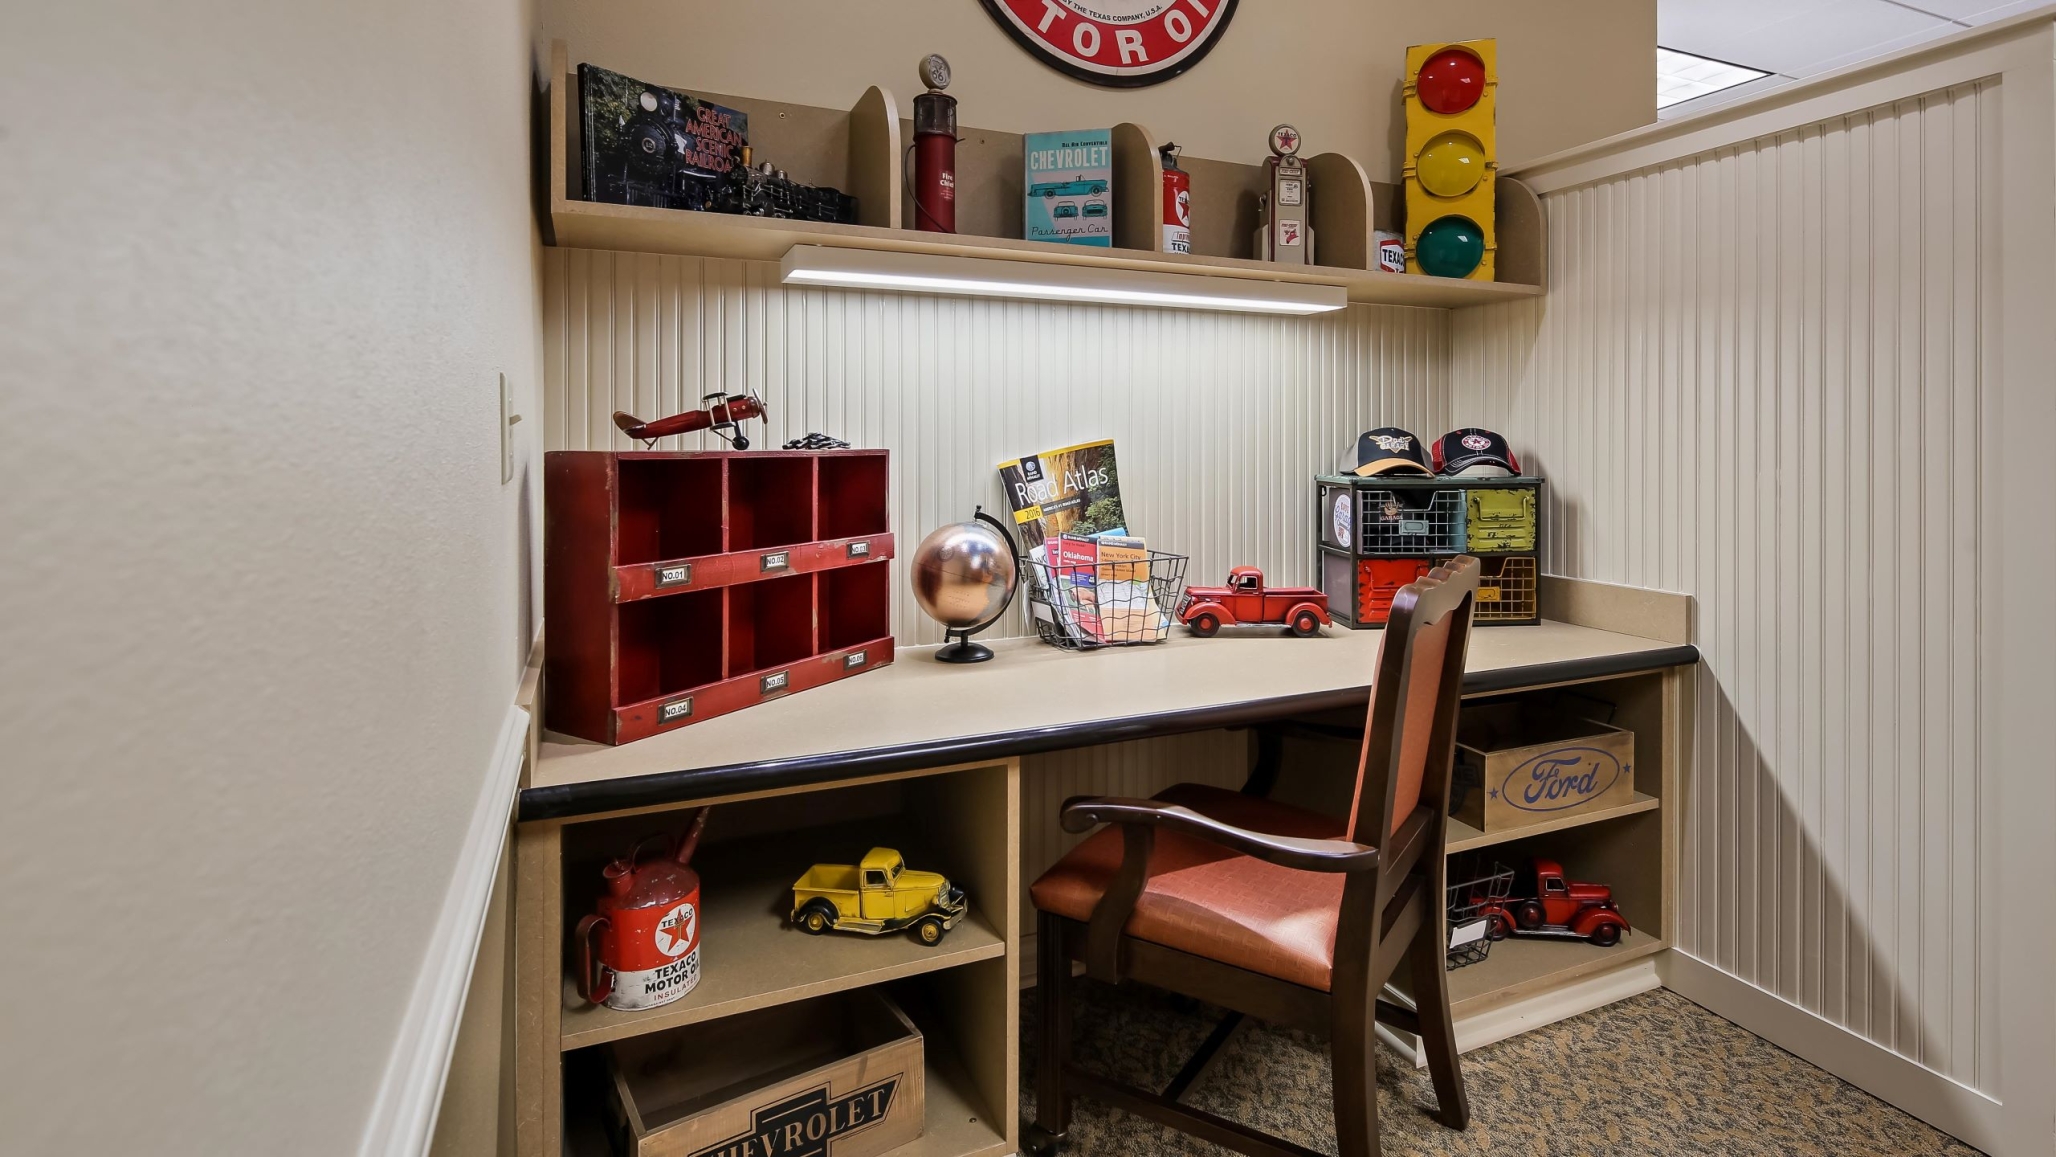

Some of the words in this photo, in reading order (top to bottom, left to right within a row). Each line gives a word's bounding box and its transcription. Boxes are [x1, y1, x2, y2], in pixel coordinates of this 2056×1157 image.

[1073, 2, 1087, 14] THE
[1088, 9, 1111, 21] TEXAS
[1112, 13, 1146, 22] COMPANY,
[696, 106, 732, 128] GREAT
[685, 118, 743, 148] AMERICAN
[695, 136, 734, 159] SCENIC
[1030, 146, 1108, 170] CHEVROLET
[685, 148, 733, 173] RAILROA
[1031, 226, 1086, 242] Passenger
[1087, 223, 1109, 233] Car
[1014, 473, 1059, 506] Road
[1063, 464, 1109, 494] Atlas
[1024, 507, 1041, 520] 2016
[766, 555, 785, 565] NO.02
[1063, 550, 1094, 562] Oklahoma
[1130, 553, 1142, 561] City
[662, 570, 684, 580] NO.01
[848, 654, 864, 664] NO.06
[766, 676, 785, 688] NO.05
[665, 703, 687, 717] NO.04
[1523, 756, 1600, 804] Ford
[661, 907, 693, 928] TEXACO
[655, 951, 696, 979] TEXACO
[645, 970, 688, 994] MOTOR
[711, 1088, 886, 1157] EVROLET
